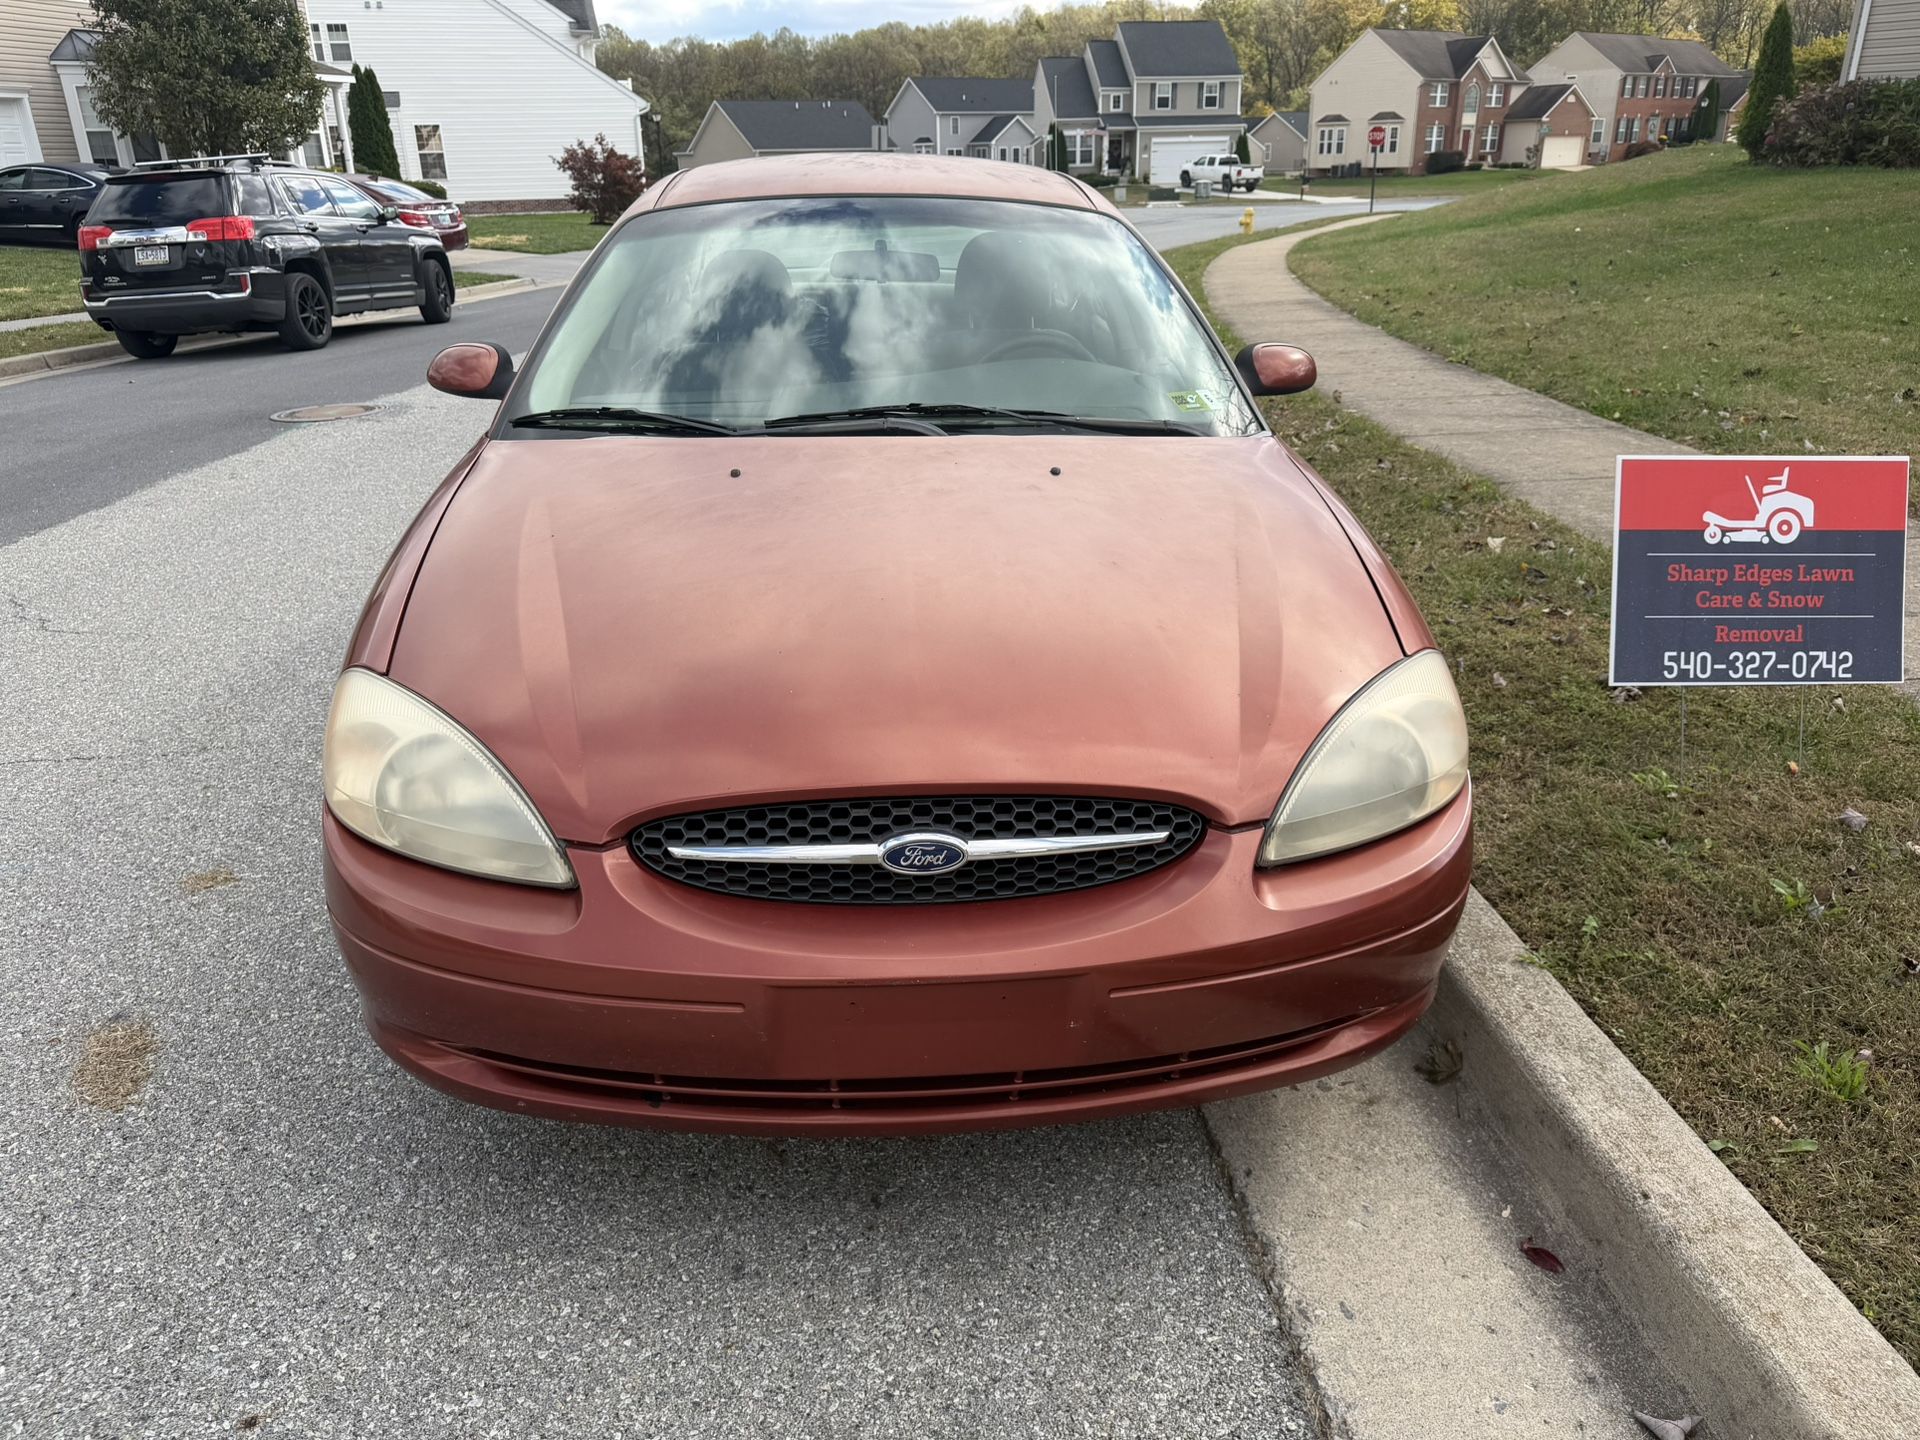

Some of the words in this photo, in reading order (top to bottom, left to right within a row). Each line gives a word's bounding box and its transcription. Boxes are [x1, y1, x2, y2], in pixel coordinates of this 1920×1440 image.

[1370, 132, 1384, 140] STOP
[1667, 564, 1728, 586] Sharp
[1733, 564, 1793, 586] Edges
[1798, 564, 1855, 582] Lawn
[1695, 591, 1743, 609] Care
[1748, 591, 1762, 609] &
[1767, 591, 1825, 609] Snow
[1714, 624, 1804, 643] Removal
[1663, 651, 1853, 679] 540-327-0742
[900, 846, 947, 866] Ford
